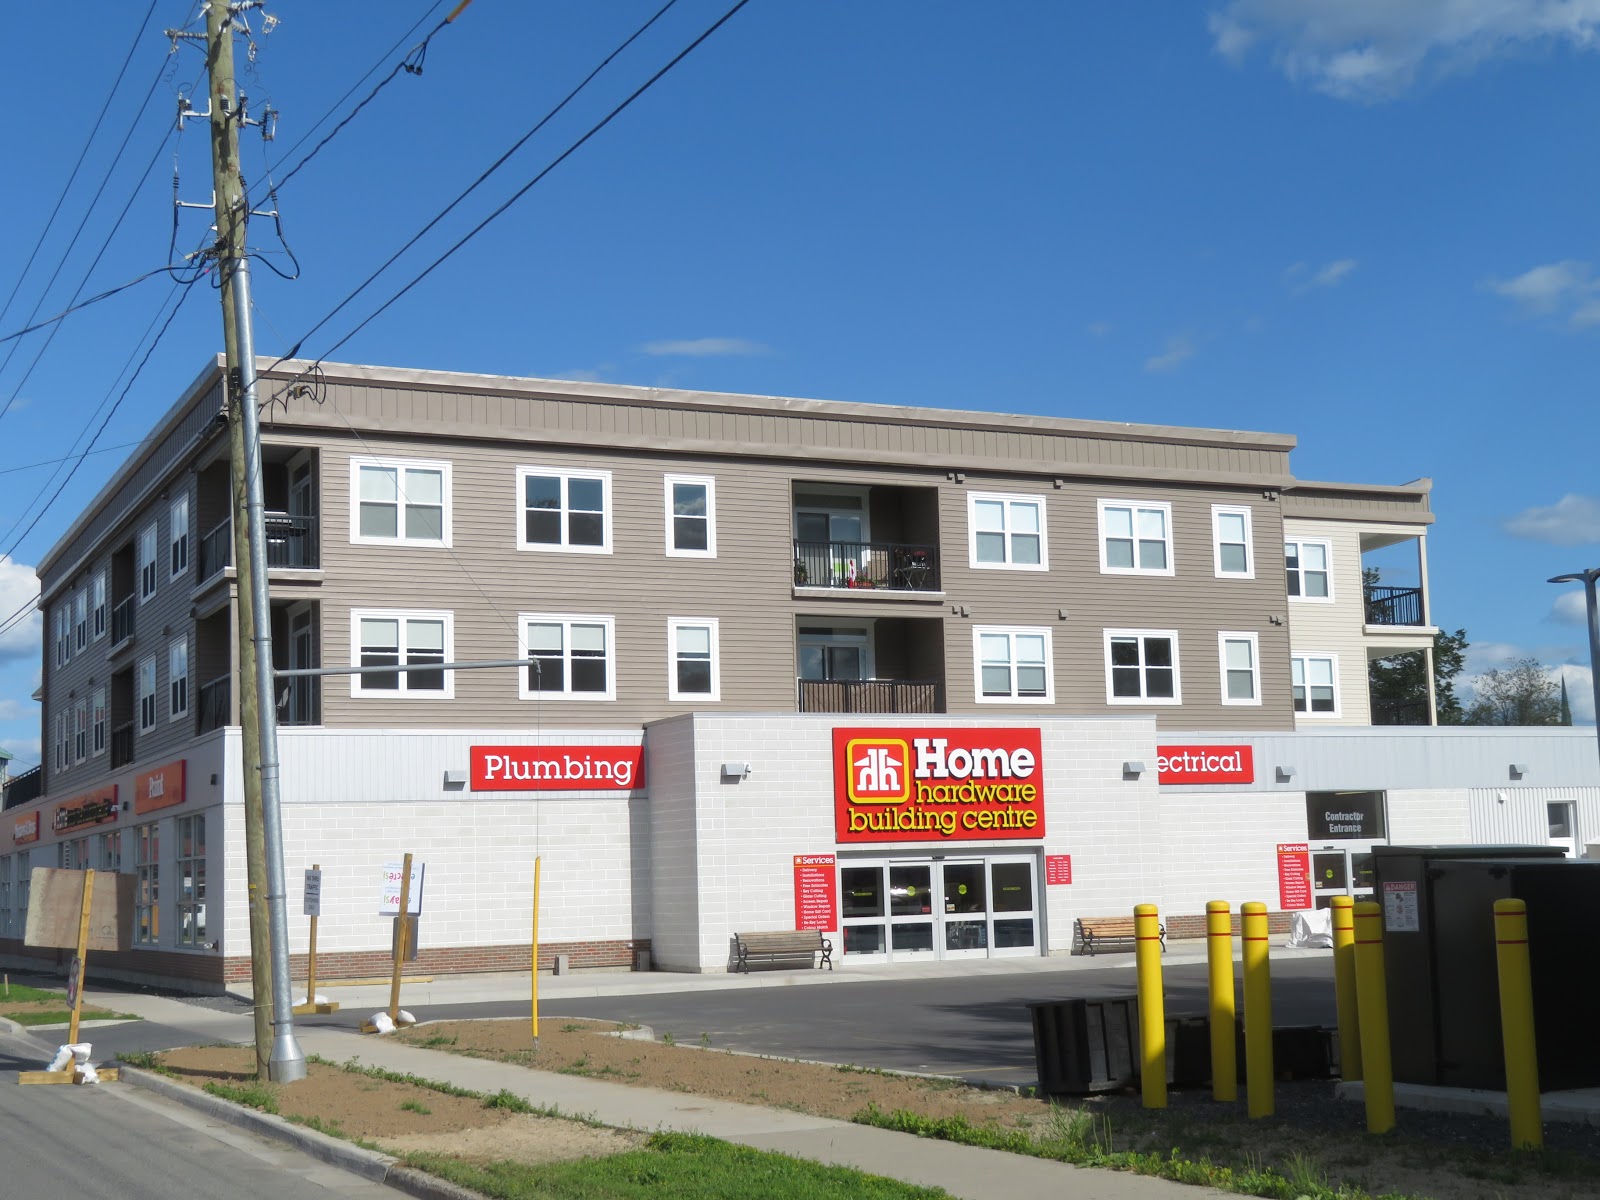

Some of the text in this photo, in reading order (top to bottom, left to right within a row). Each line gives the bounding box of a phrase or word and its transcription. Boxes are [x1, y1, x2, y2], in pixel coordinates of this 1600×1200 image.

[914, 738, 1035, 778] Home
[1157, 751, 1242, 772] ectrical
[484, 756, 632, 785] Plumbing
[915, 780, 1036, 803] hardware
[848, 806, 1038, 834] building centre
[1325, 812, 1364, 821] Contractor
[1329, 823, 1362, 833] Entrance
